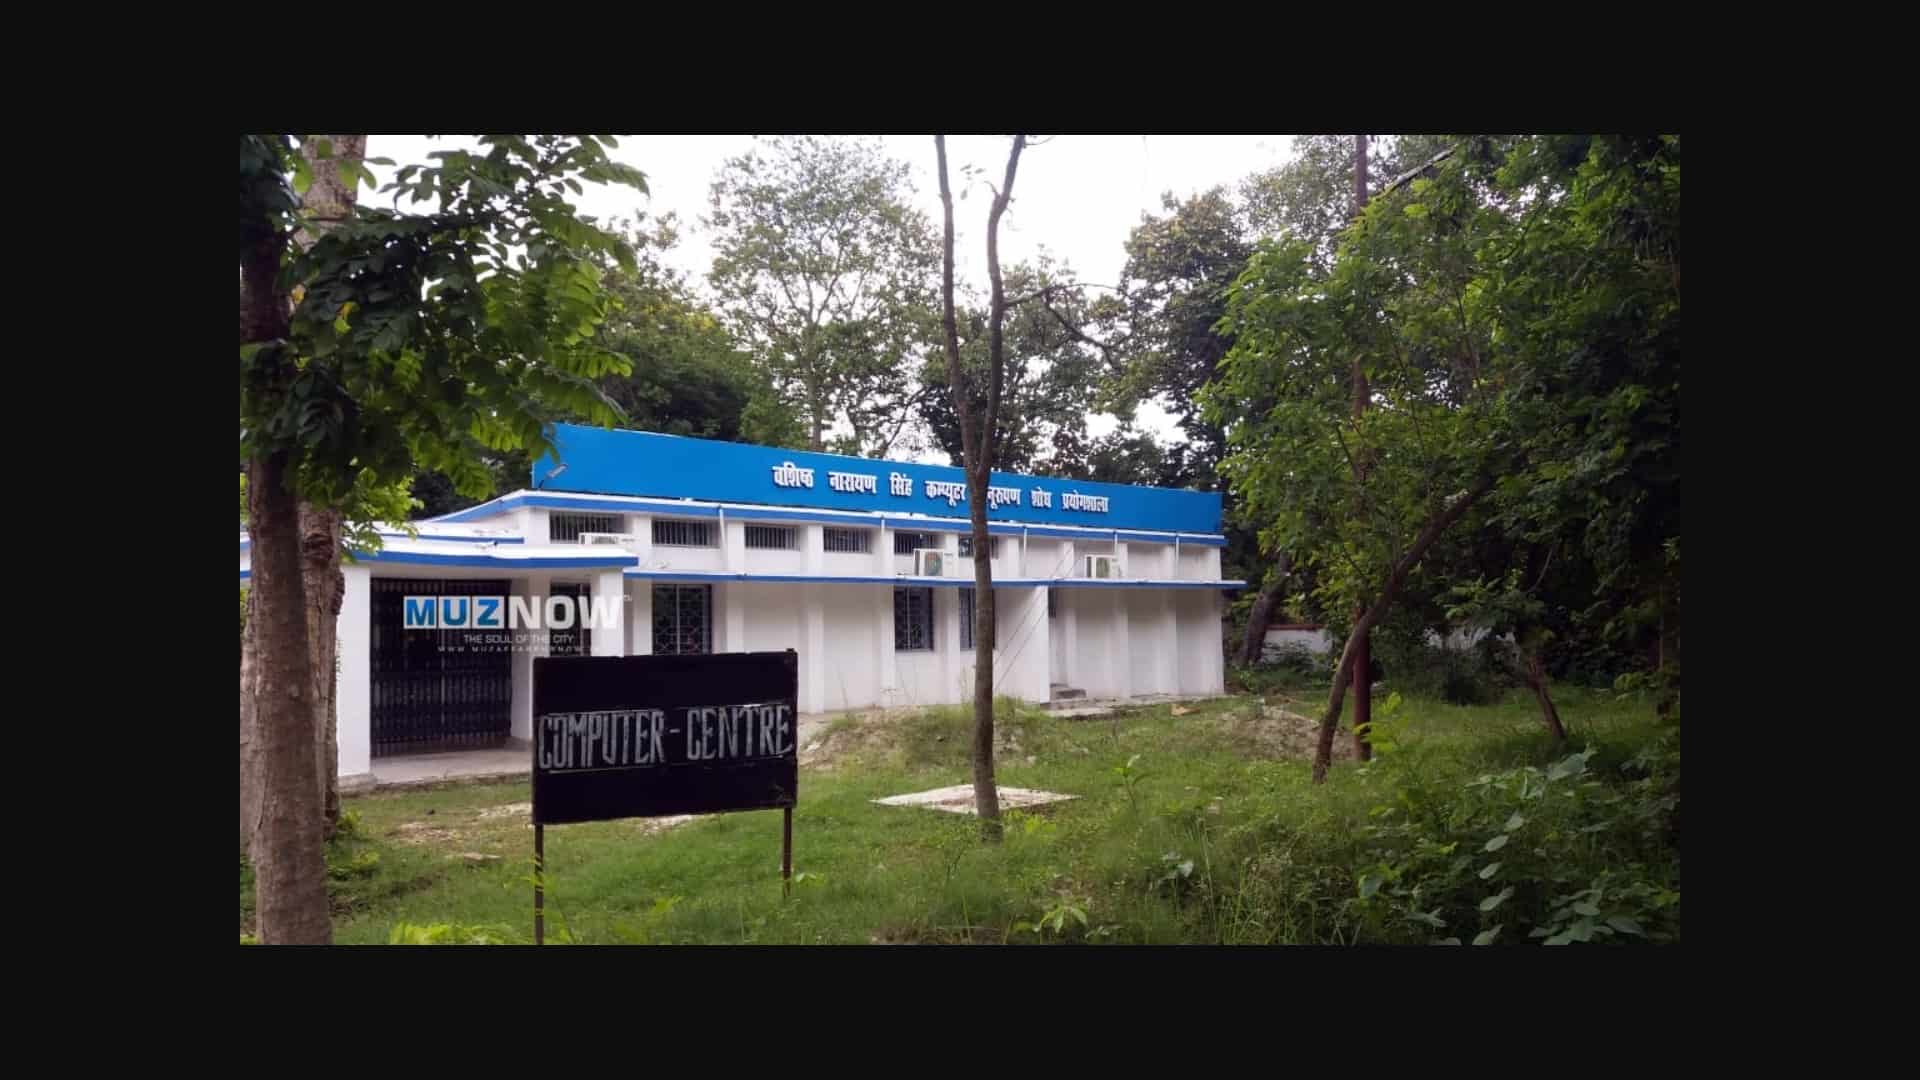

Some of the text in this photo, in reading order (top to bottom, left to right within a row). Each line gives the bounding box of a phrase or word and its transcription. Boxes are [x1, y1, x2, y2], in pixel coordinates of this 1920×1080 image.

[828, 471, 877, 495] नारायण
[889, 471, 913, 497] सिंह
[1030, 486, 1052, 508] शोध
[1061, 488, 1109, 513] प्रयोगशाला
